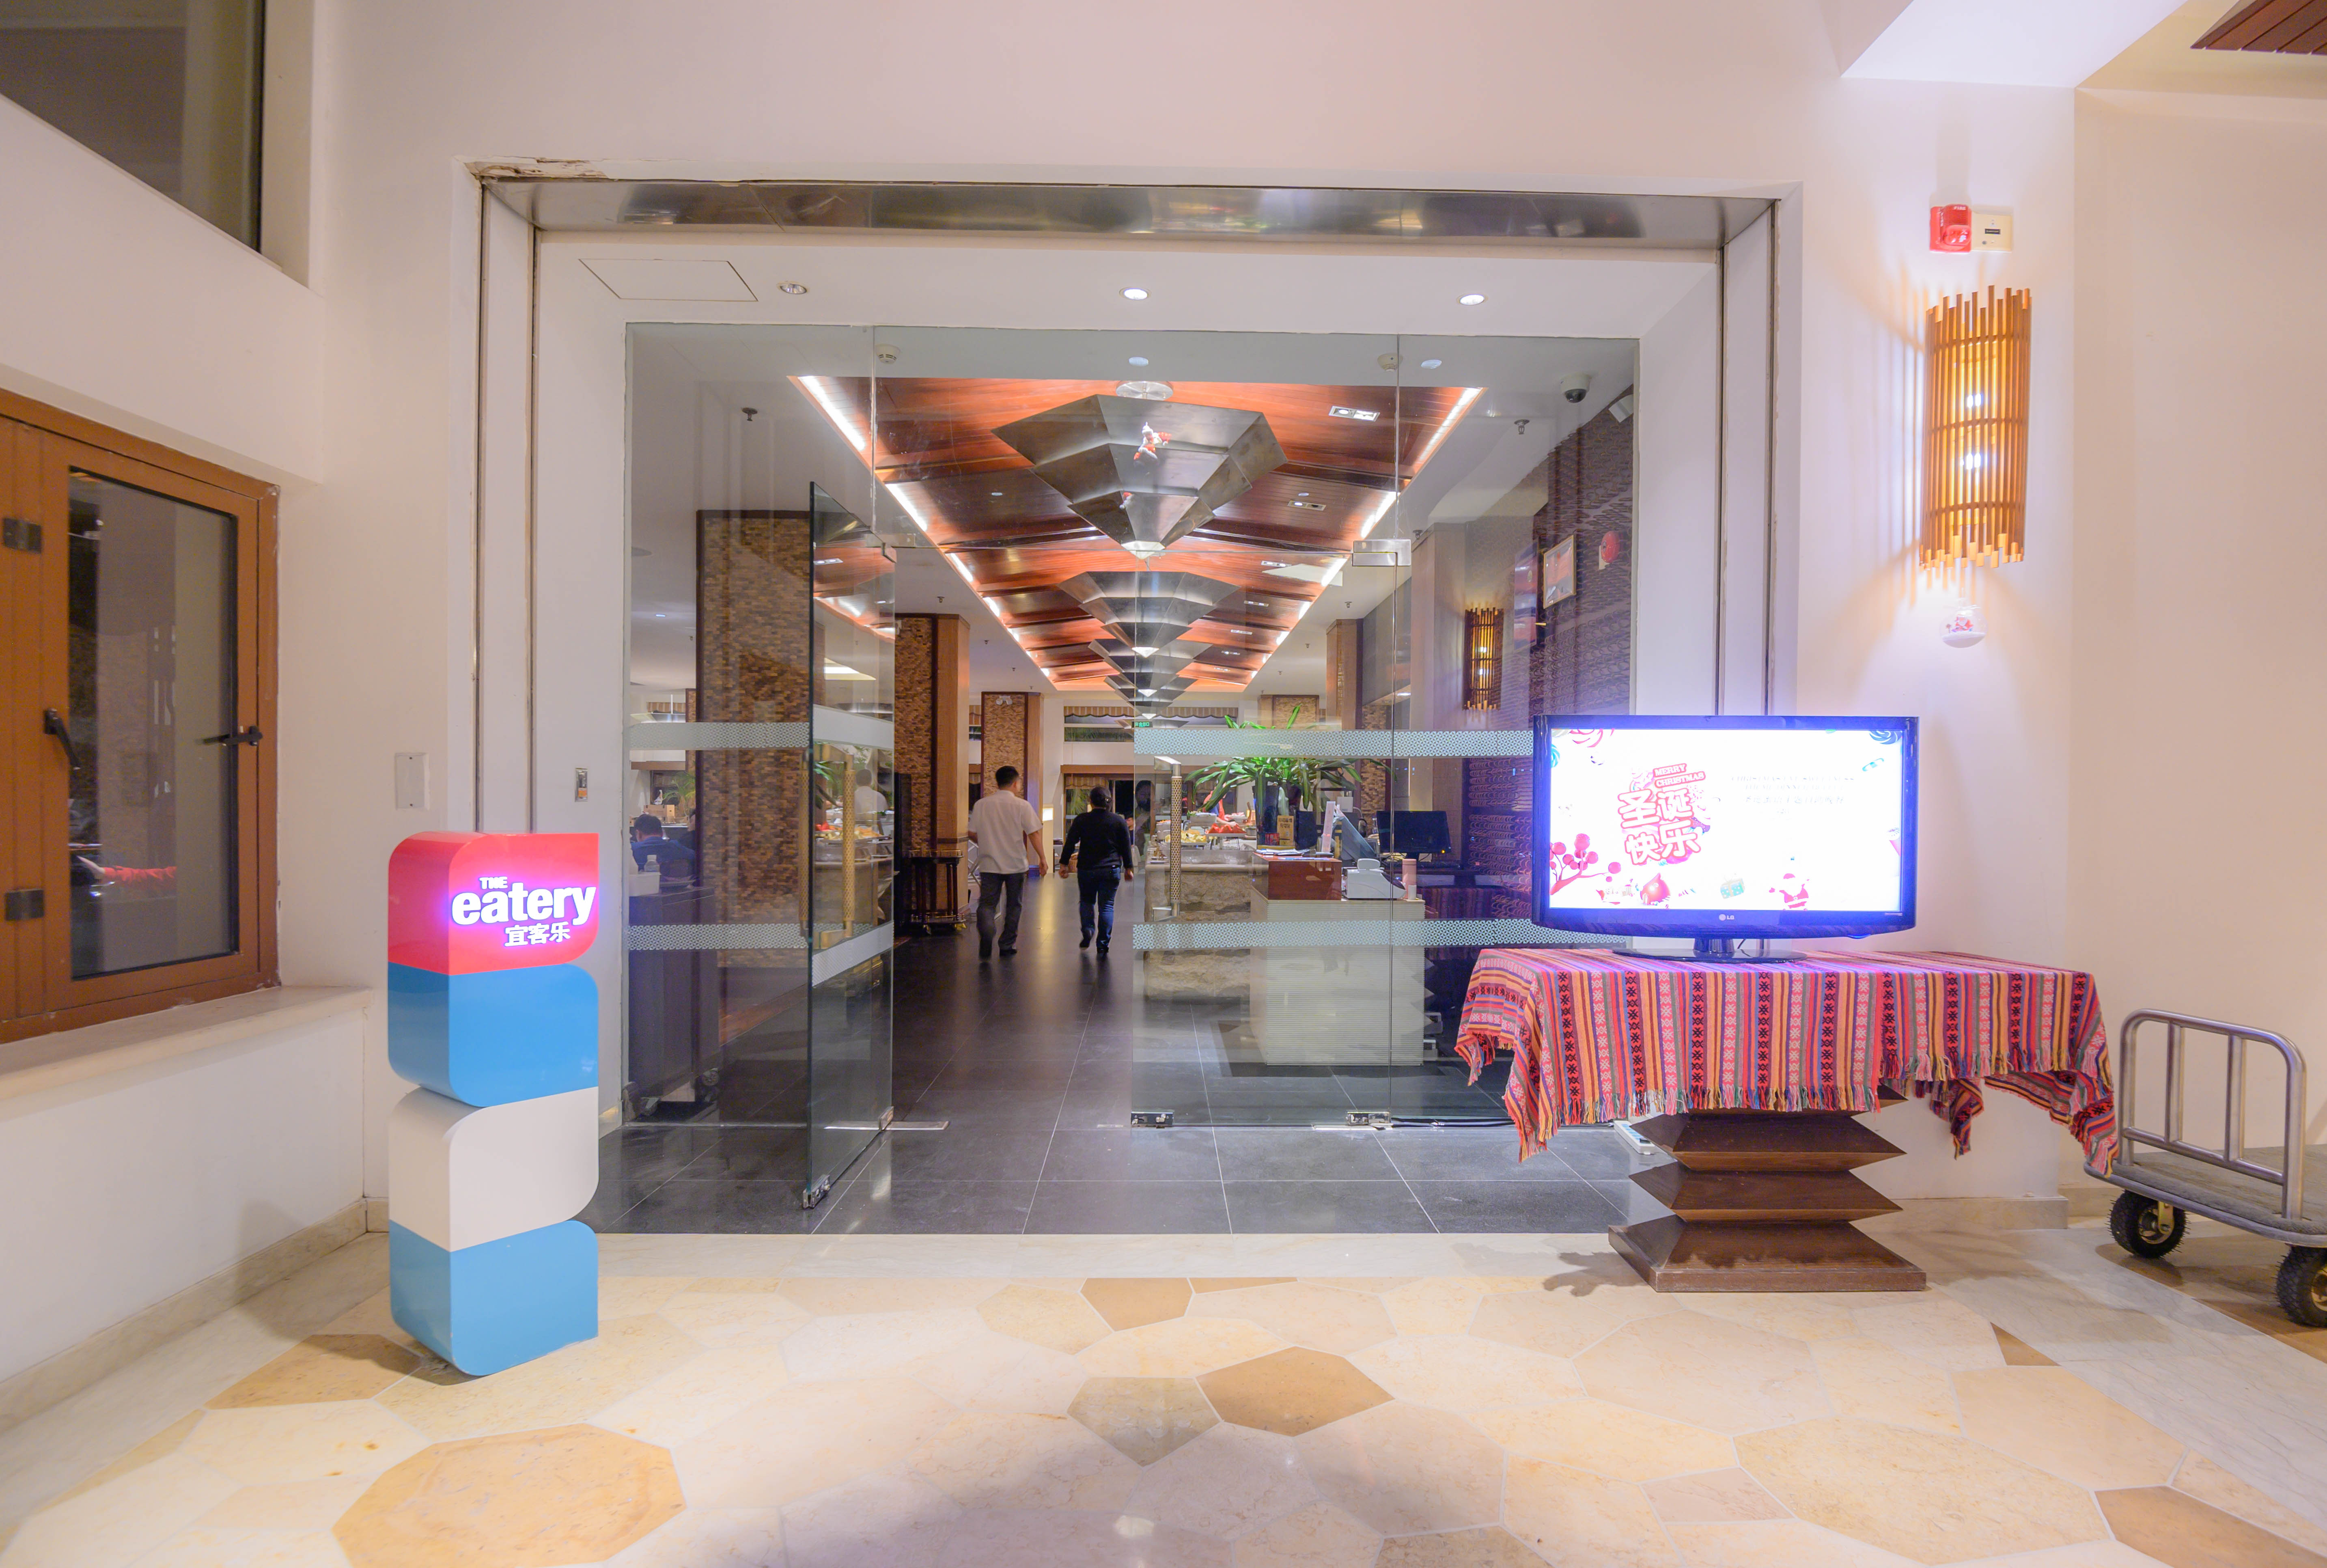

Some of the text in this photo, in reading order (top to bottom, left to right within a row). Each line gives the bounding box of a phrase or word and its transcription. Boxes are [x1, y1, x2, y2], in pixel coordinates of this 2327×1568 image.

[1654, 764, 1686, 777] MERRY
[1655, 772, 1705, 787] CHRISTMAS
[1618, 789, 1694, 828] 圣诞
[1625, 820, 1700, 864] 快乐
[479, 876, 508, 890] THE
[452, 882, 597, 926] eatery
[504, 921, 571, 947] 宜客乐
